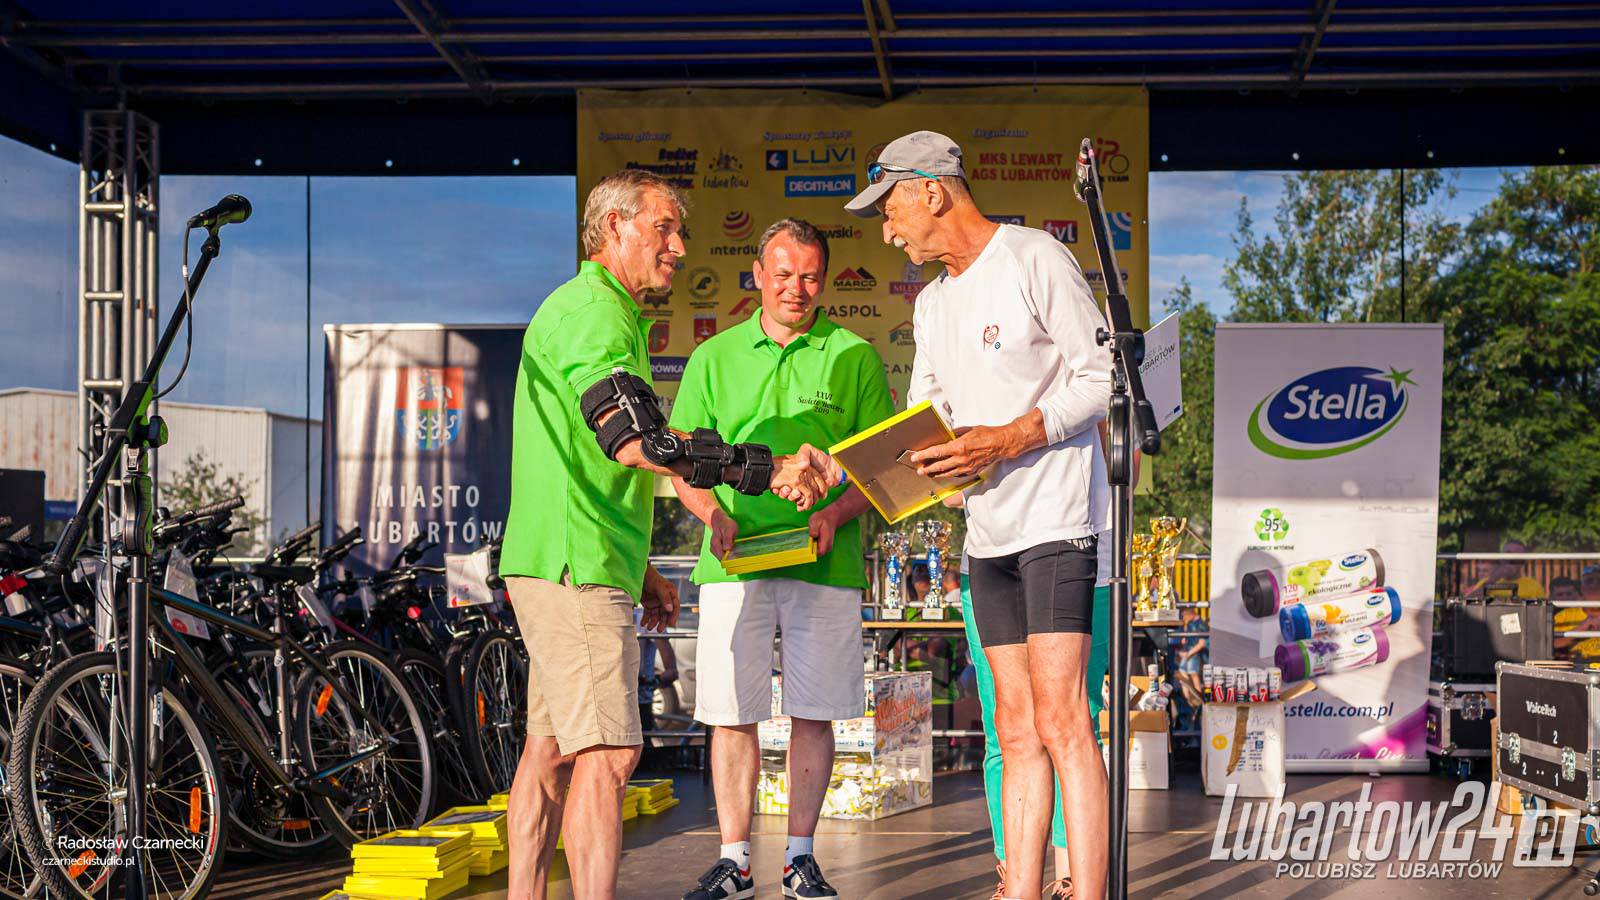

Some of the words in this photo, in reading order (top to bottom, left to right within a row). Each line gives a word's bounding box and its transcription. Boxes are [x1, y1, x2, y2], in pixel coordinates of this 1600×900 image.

[979, 153, 1007, 166] MKS
[1011, 153, 1063, 166] LEWART
[971, 167, 999, 181] AGS
[1001, 165, 1072, 182] LUBARTÓW
[789, 179, 851, 193] DECATHLON
[833, 280, 877, 288] MARCO
[1283, 383, 1387, 420] Stella
[376, 484, 480, 508] MIASTO
[353, 517, 502, 545] UBARTÓW
[1284, 702, 1394, 720] .stella.com.pl
[1552, 730, 1559, 745] 2
[1521, 761, 1528, 776] 2
[1554, 773, 1559, 787] 1
